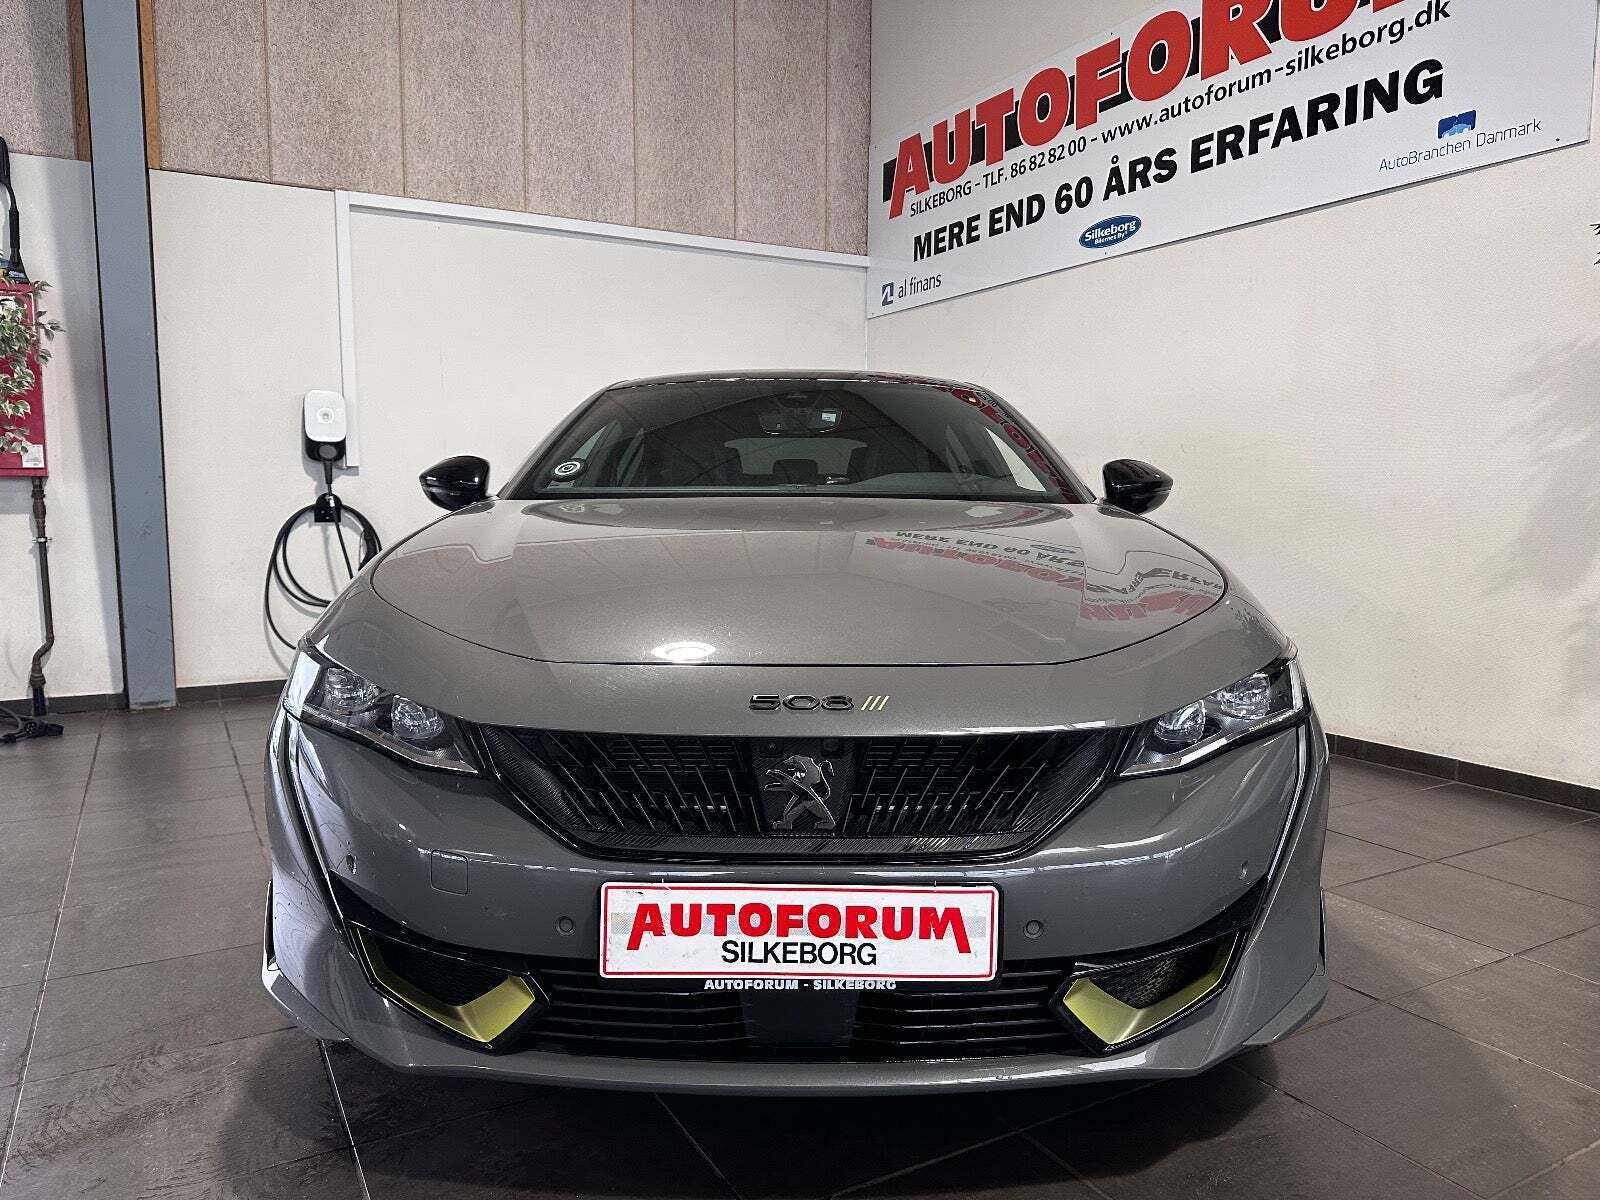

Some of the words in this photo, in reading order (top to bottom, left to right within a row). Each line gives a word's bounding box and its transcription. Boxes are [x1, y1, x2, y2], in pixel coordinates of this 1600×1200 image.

[888, 0, 1408, 220] AUTOFORU
[910, 181, 972, 217] SILKEBORG
[982, 168, 1008, 189] TLF.
[1101, 0, 1451, 141] www.autoforum-silkeborg.dk
[912, 213, 981, 262] MERE
[988, 193, 1046, 237] END
[1054, 175, 1094, 215] 60
[1102, 154, 1178, 201] ÅRS
[1190, 58, 1444, 173] ERFARING
[1379, 138, 1471, 173] AutoBranchen
[1476, 118, 1542, 147] Danmark
[1084, 220, 1137, 242] Silkeborg
[897, 278, 907, 299] al
[908, 273, 942, 296] finans
[748, 694, 854, 712] 508
[626, 902, 972, 955] AUTOFORUM
[720, 939, 877, 967] SILKEBORG
[704, 979, 799, 990] AUTOFORUM
[813, 979, 897, 990] SILKEBORG
